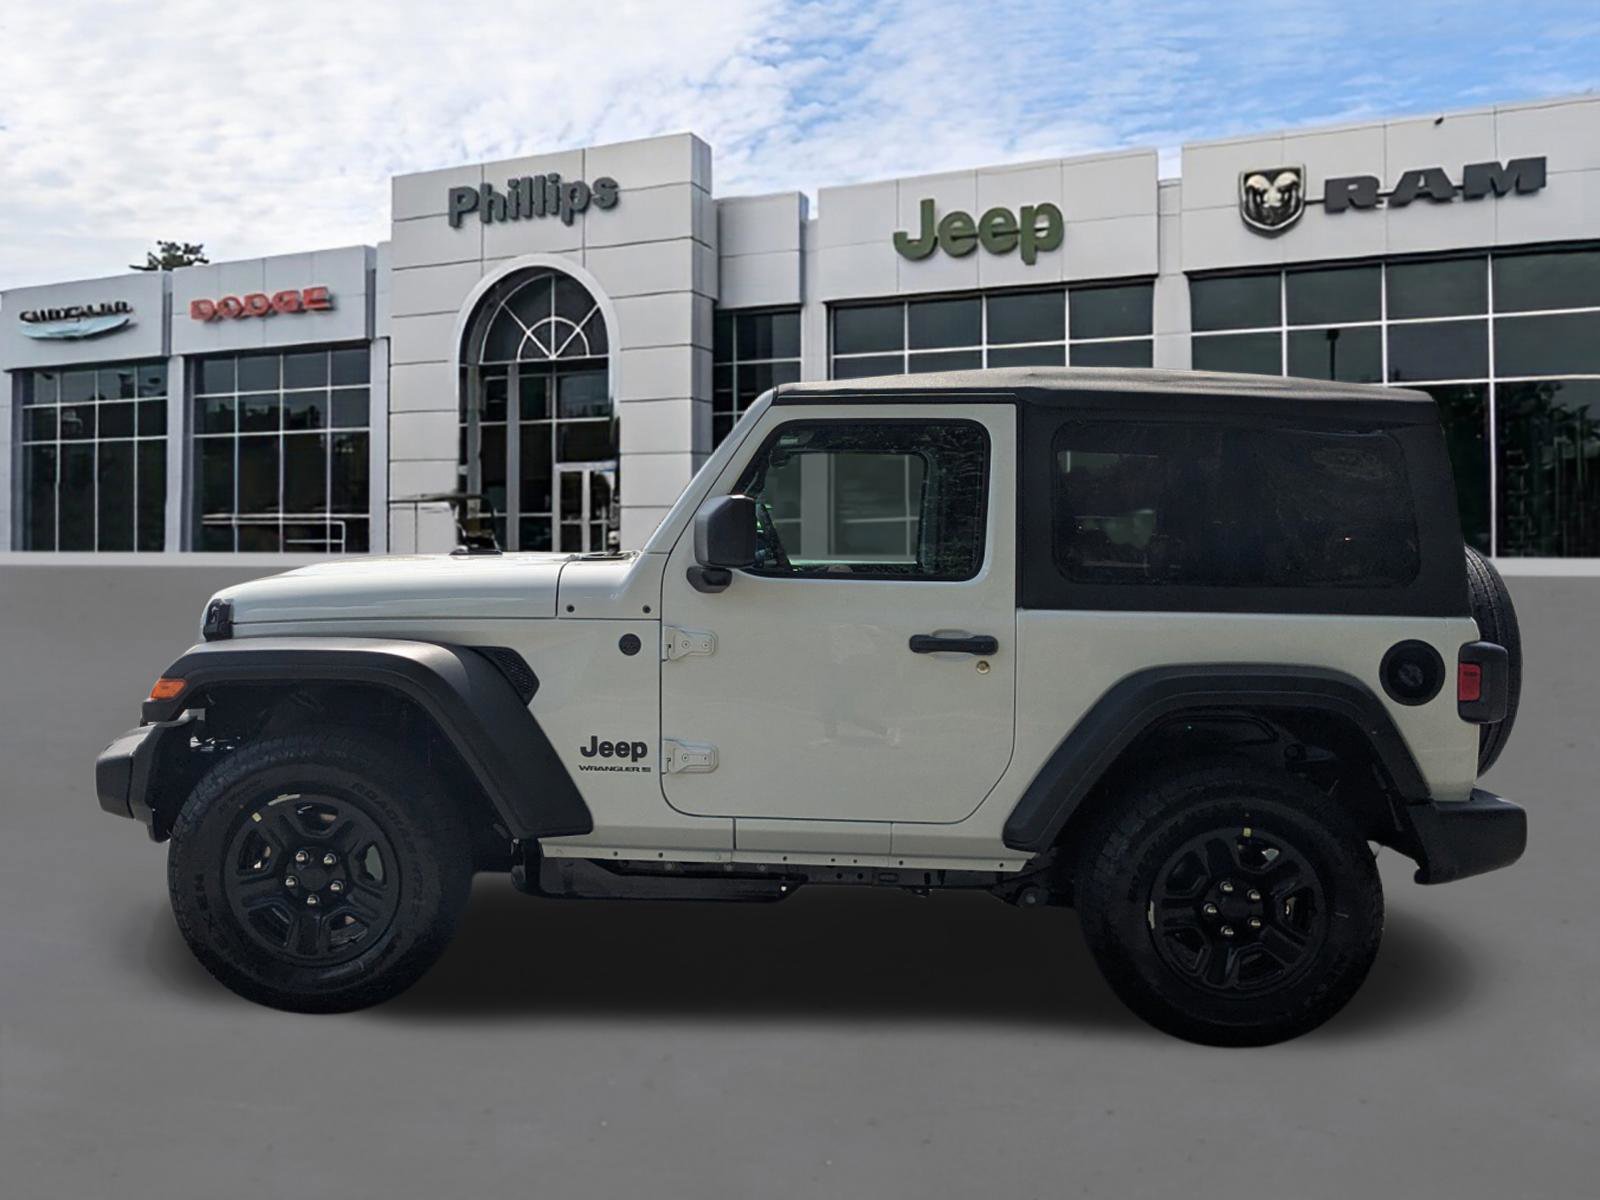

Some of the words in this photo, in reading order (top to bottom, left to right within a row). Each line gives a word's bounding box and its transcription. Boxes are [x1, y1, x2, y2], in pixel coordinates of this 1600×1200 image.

[448, 173, 619, 228] Phillips
[1324, 156, 1547, 214] RAM
[893, 198, 1064, 266] Jeep
[190, 286, 334, 323] DODGE
[579, 765, 640, 773] WRANGLER
[580, 735, 648, 762] Jeep
